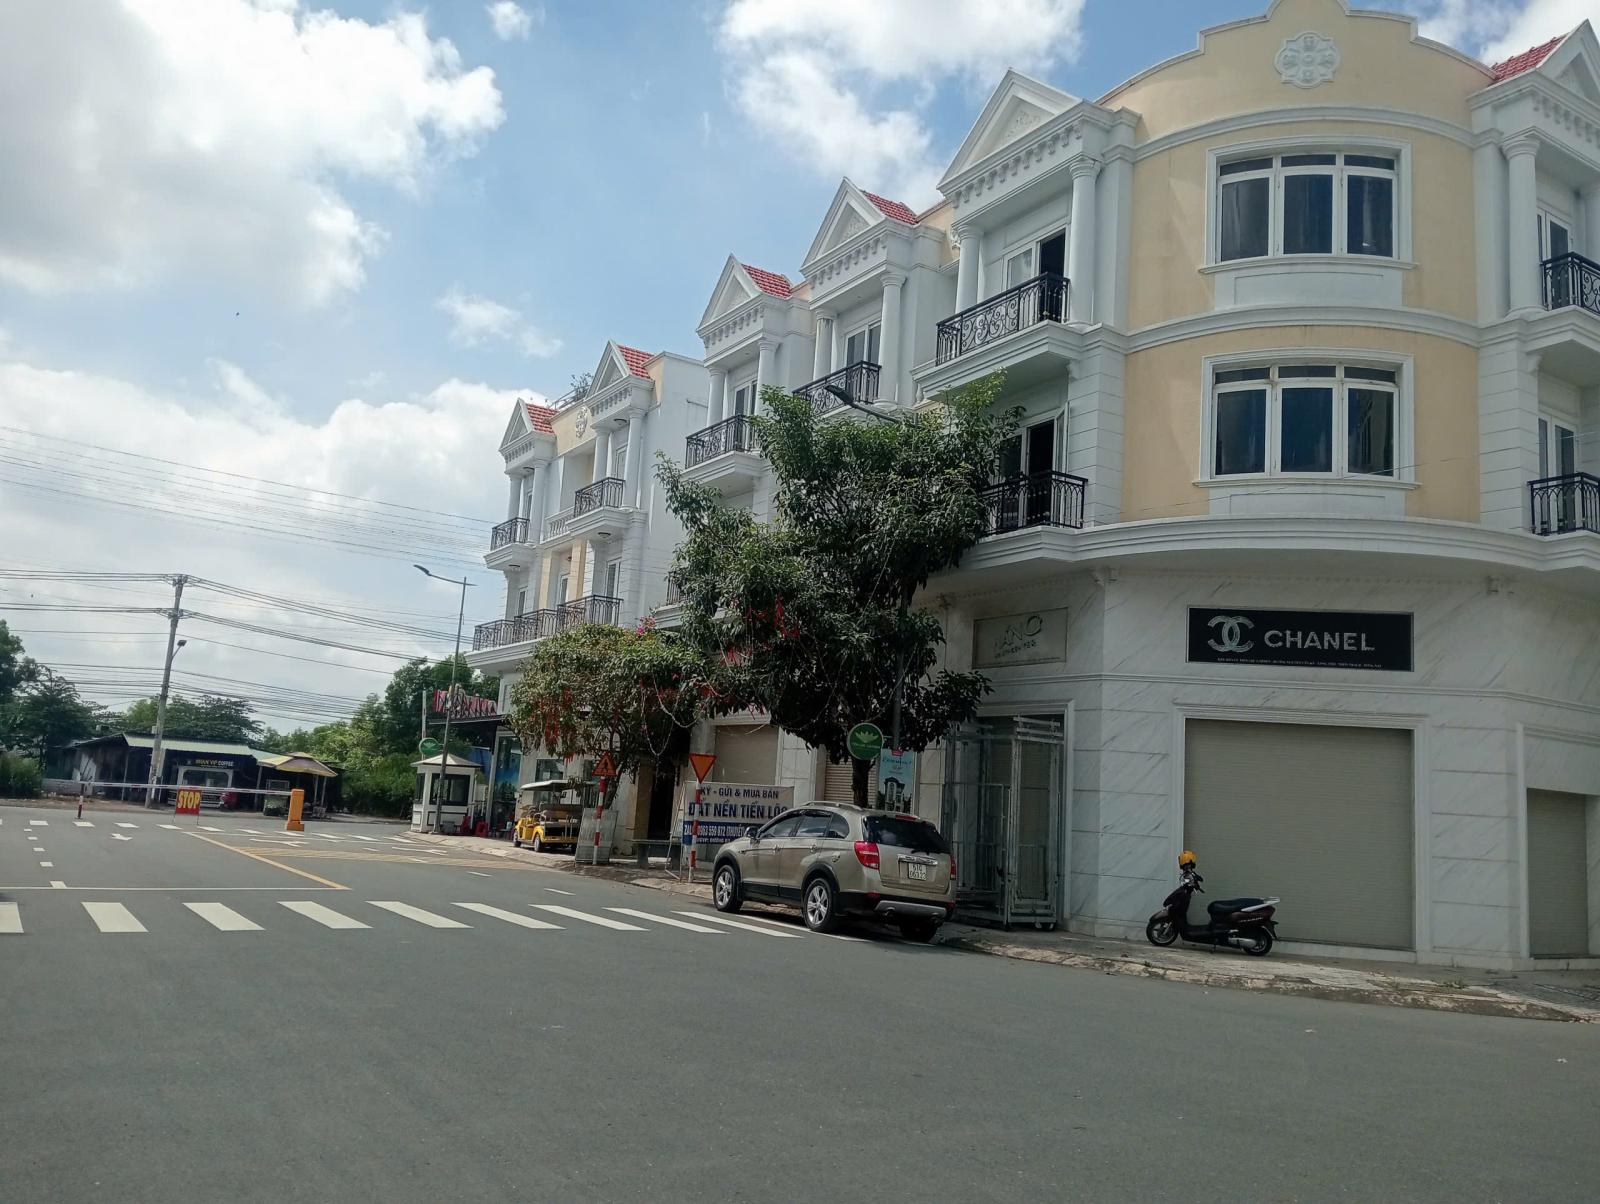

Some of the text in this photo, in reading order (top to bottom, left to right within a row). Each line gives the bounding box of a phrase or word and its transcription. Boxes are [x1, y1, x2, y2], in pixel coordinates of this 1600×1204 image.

[1264, 630, 1375, 651] CHANEL
[178, 790, 201, 809] STOP
[743, 789, 760, 799] MUA
